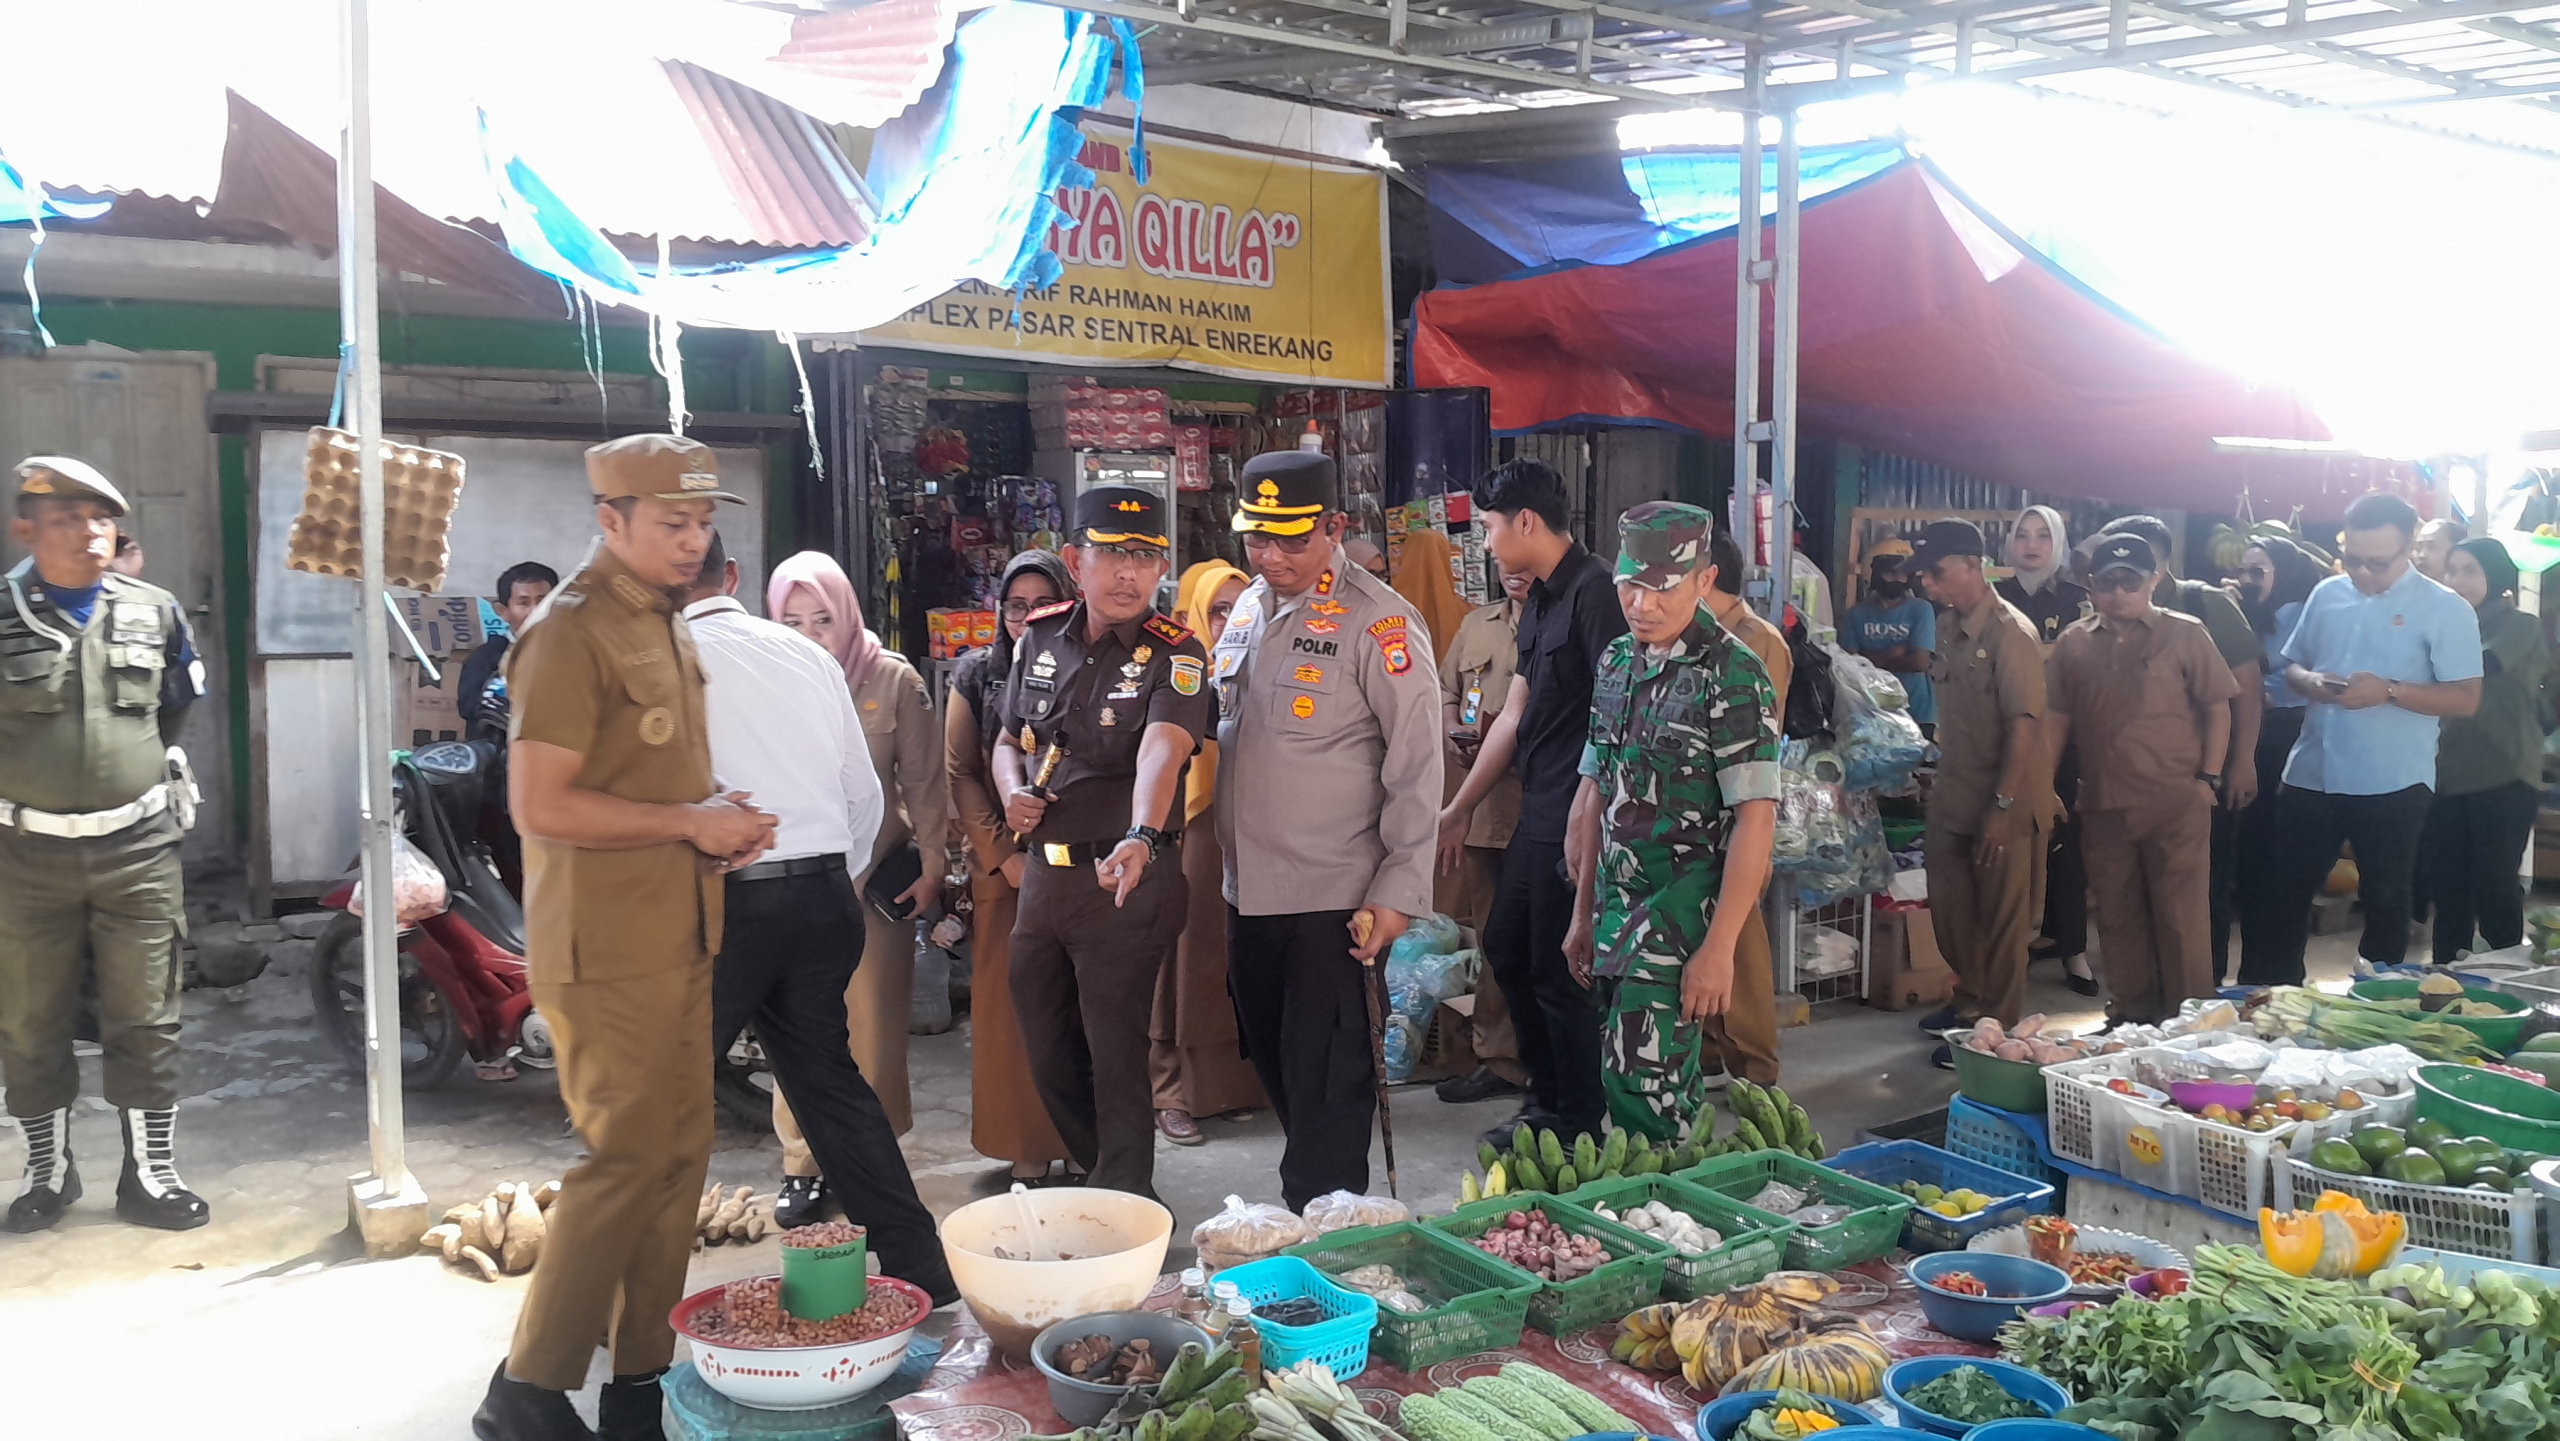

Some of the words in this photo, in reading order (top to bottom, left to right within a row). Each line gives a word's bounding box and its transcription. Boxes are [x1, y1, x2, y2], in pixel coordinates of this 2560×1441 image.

[1050, 188, 1124, 263] YA
[1069, 284, 1172, 314] RAHMAN
[1179, 297, 1252, 323] HAKIM
[988, 307, 1076, 338] PASAR
[1084, 316, 1200, 347] SENTRAL
[1205, 328, 1333, 362] ENREKANG
[1292, 637, 1339, 657] POLRI
[1863, 622, 1910, 636] BOSS
